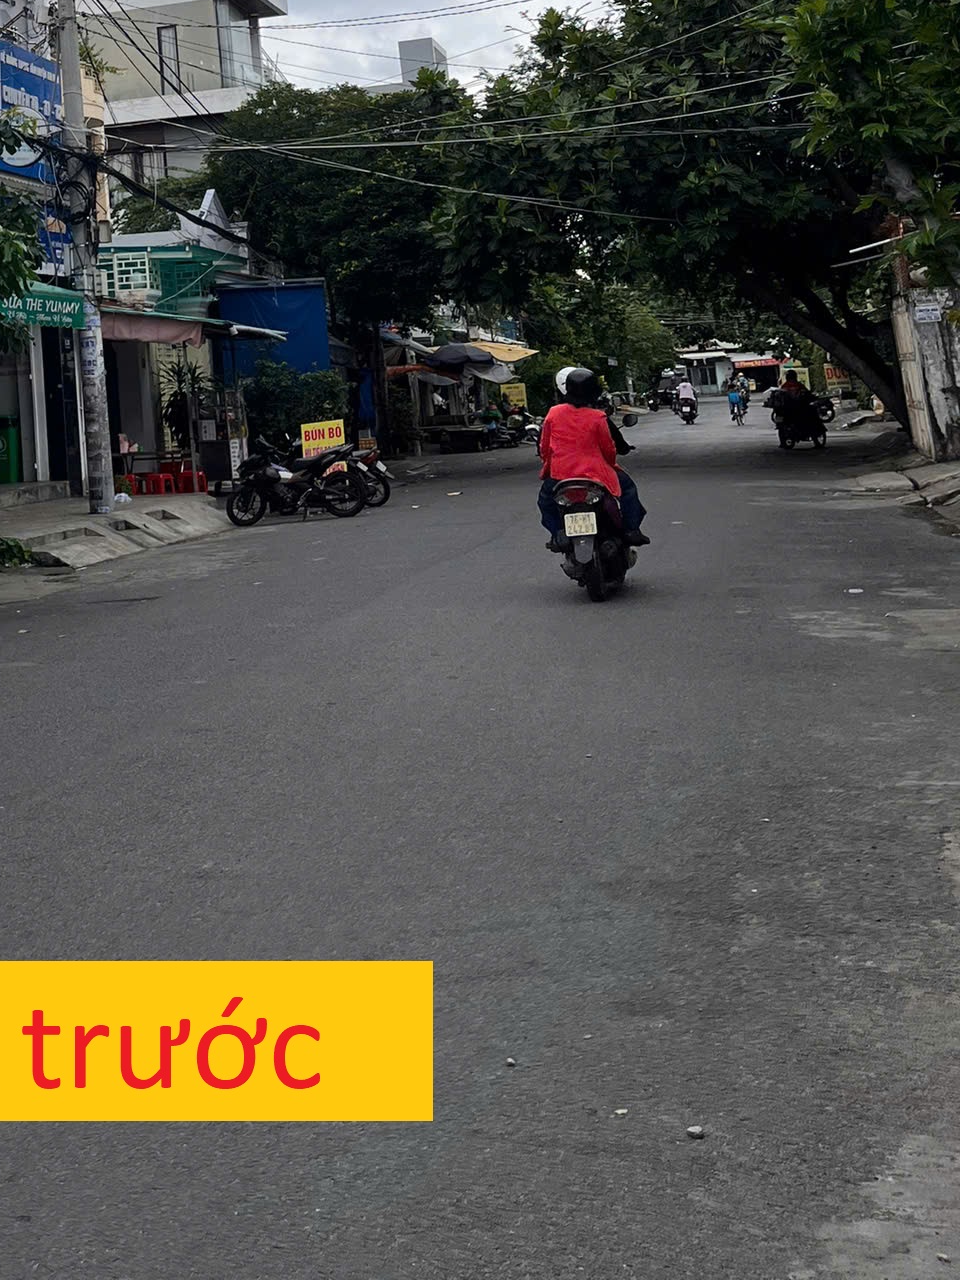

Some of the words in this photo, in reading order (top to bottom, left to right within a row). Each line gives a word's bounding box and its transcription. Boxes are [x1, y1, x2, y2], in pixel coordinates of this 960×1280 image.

[25, 297, 43, 312] THE
[45, 300, 80, 315] YUMMY
[304, 428, 325, 441] BÚN
[328, 424, 342, 438] BÒ
